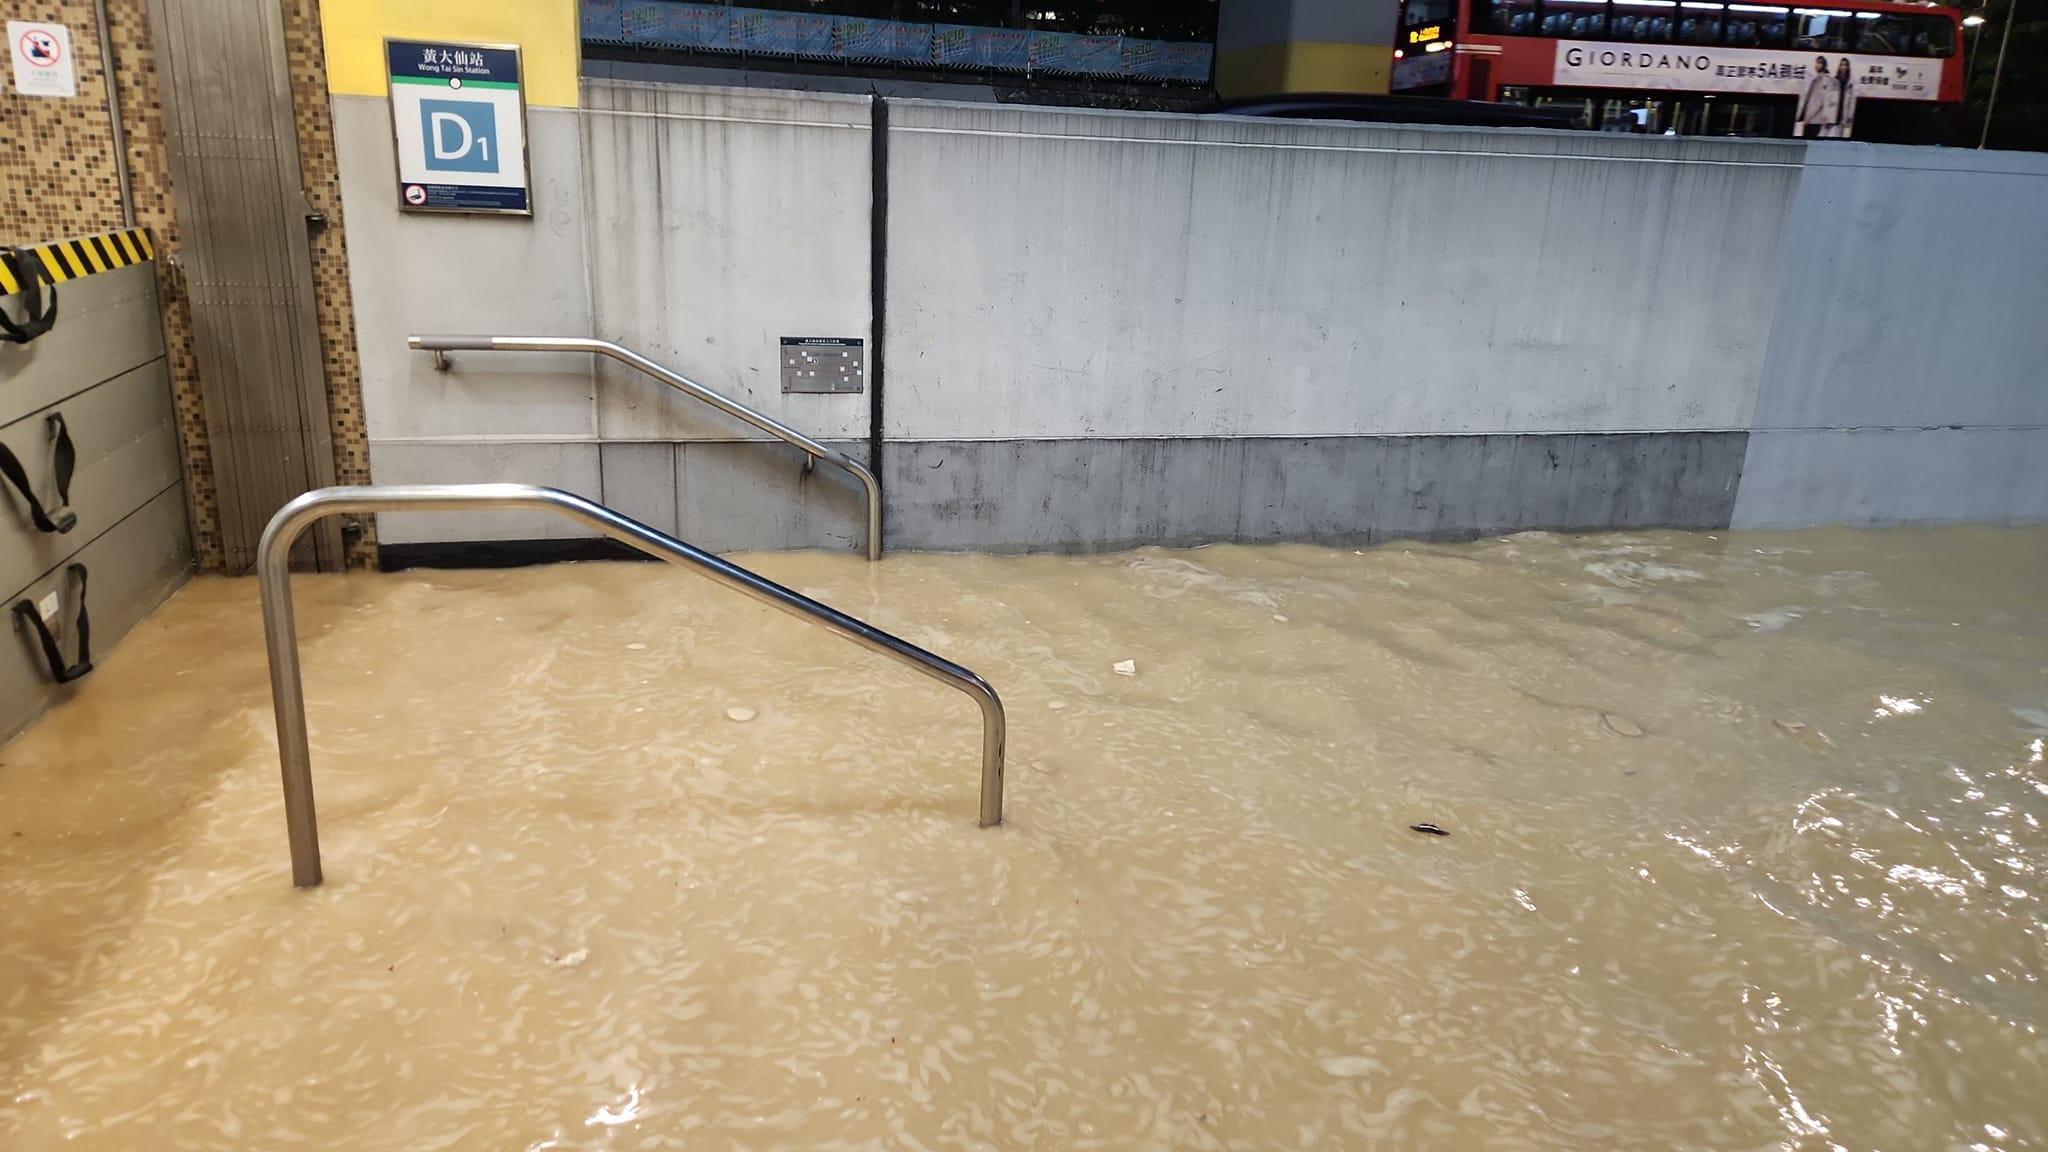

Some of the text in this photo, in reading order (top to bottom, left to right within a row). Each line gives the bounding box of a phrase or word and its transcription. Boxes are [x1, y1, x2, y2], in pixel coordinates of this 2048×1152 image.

[1565, 47, 1711, 71] GIORDANO
[417, 63, 440, 73] Wong
[452, 65, 464, 73] Sin
[464, 67, 490, 75] Station
